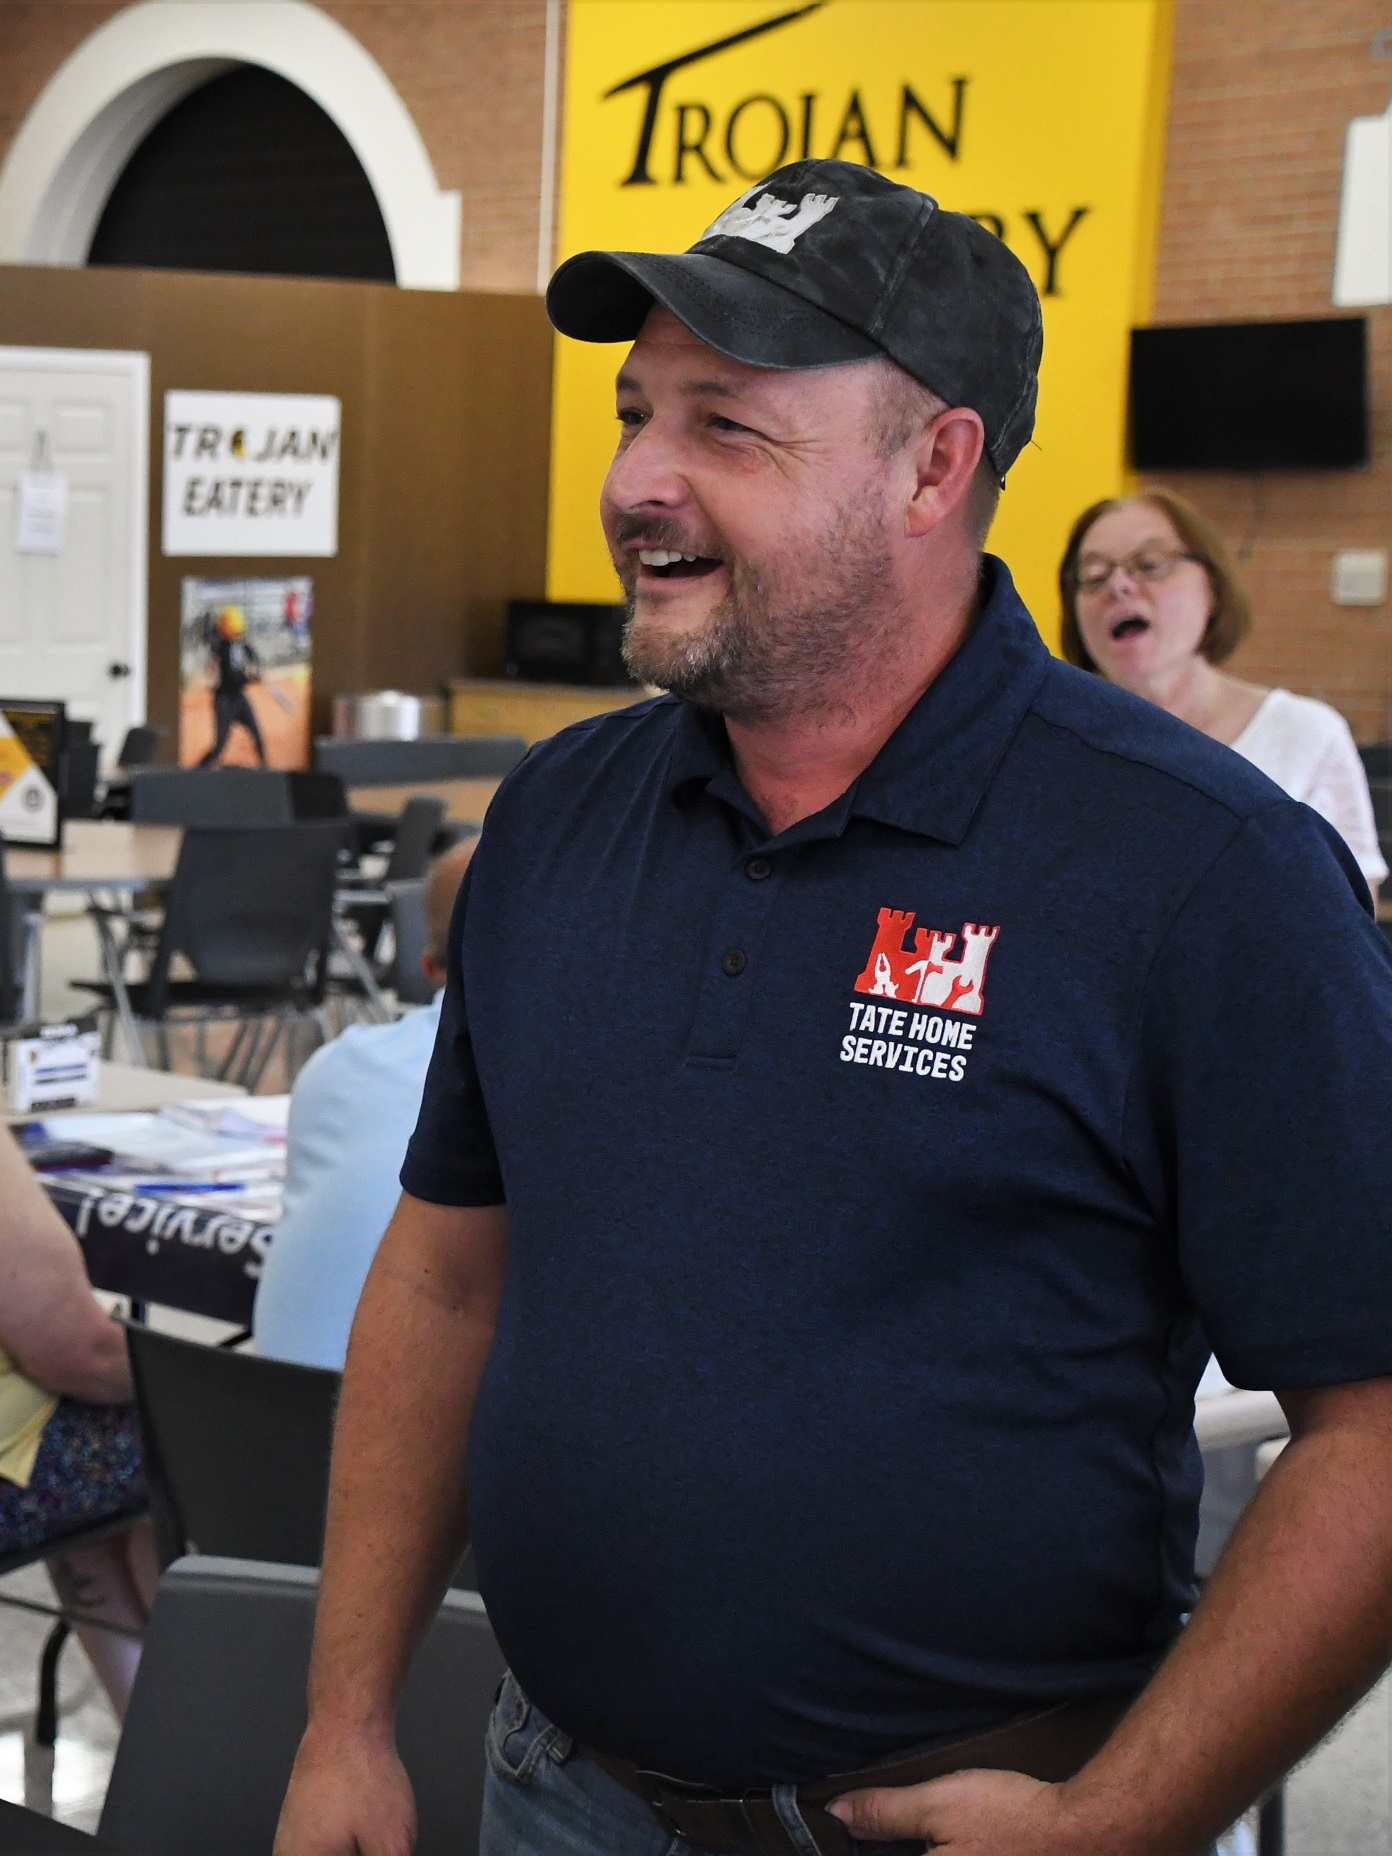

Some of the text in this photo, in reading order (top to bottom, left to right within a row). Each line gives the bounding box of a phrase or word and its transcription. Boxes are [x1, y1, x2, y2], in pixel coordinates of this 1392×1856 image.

[181, 474, 314, 519] EATERY
[849, 1002, 977, 1051] TATE HOME
[840, 1035, 968, 1082] SERVICES
